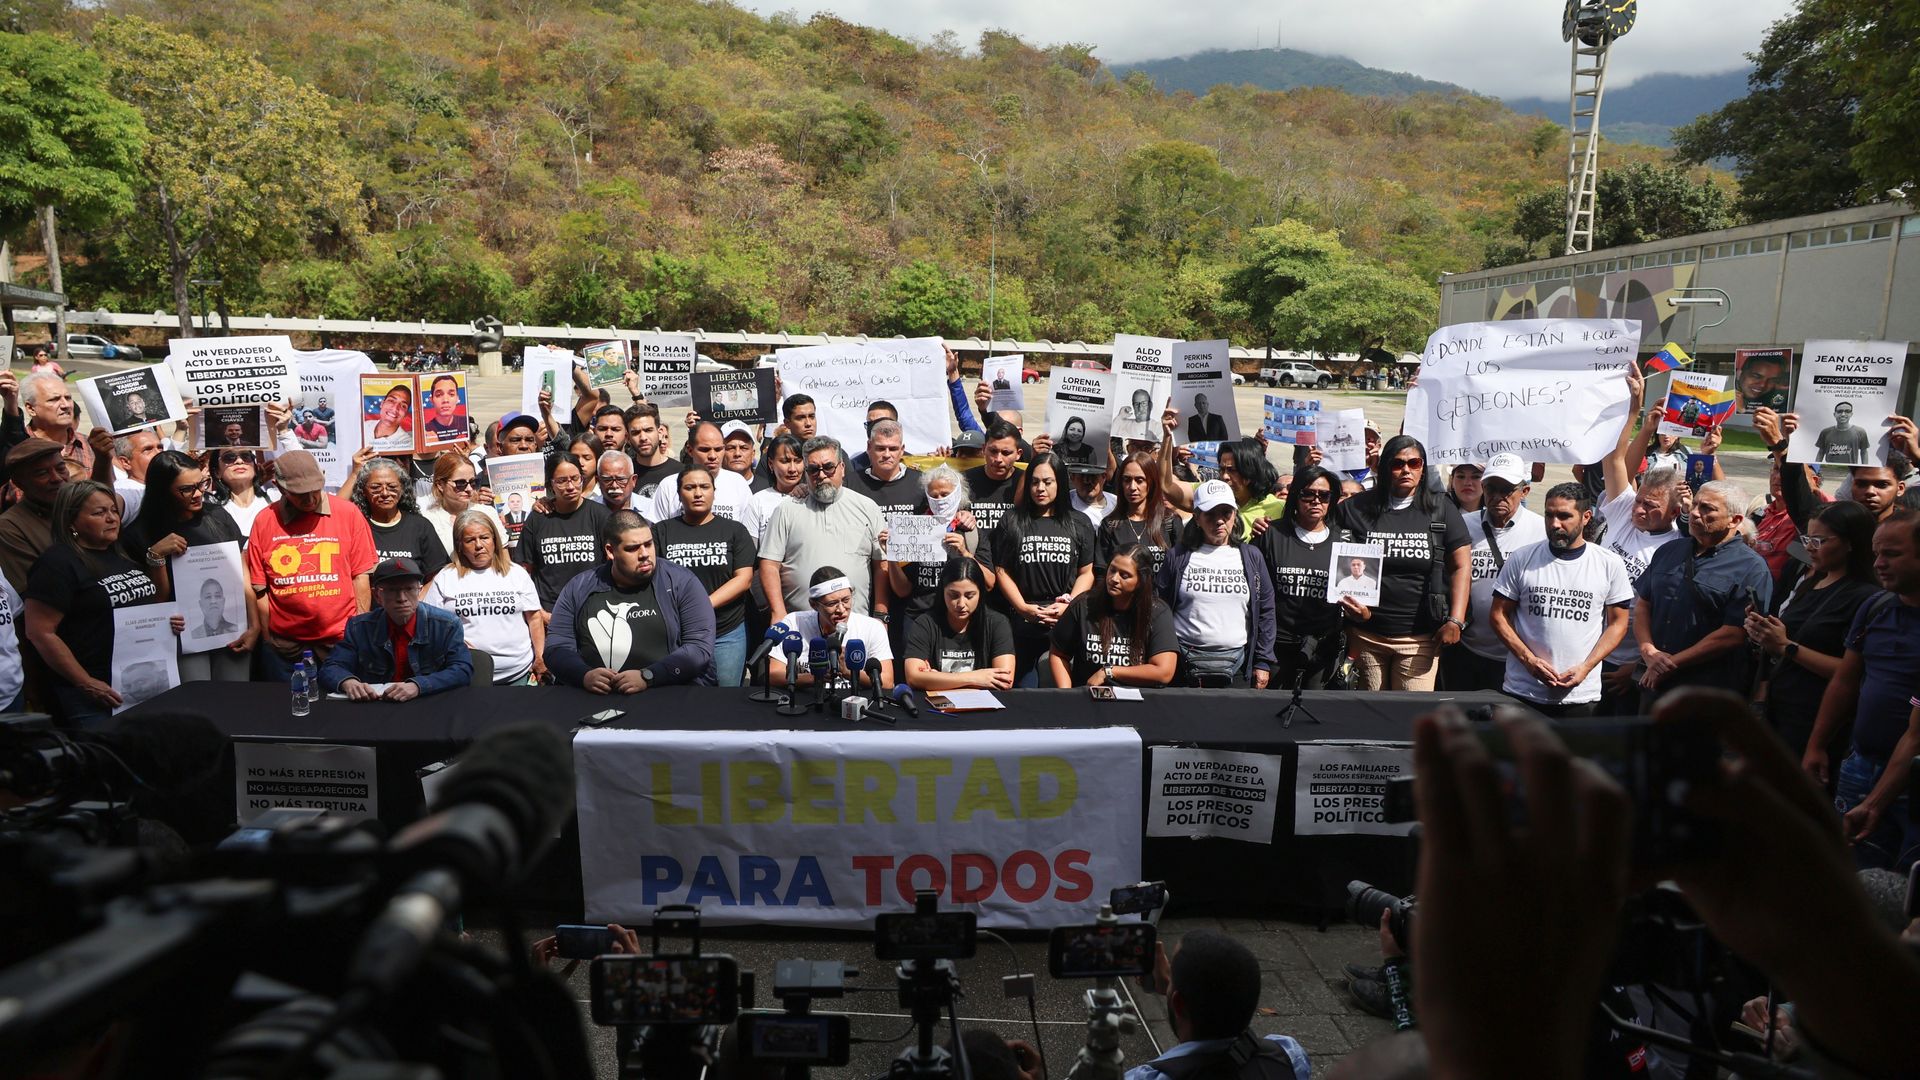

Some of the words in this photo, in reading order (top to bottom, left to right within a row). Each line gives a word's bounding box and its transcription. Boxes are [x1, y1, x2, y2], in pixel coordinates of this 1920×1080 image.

[1504, 326, 1563, 348] ESTÁN
[192, 349, 208, 357] UN
[210, 346, 272, 356] VERDADERO
[1136, 347, 1162, 356] ALDO
[1596, 346, 1628, 356] SEAN
[1136, 355, 1160, 363] ROSO
[645, 362, 656, 370] NI
[659, 362, 674, 370] AL
[676, 362, 689, 370] 1%
[1126, 363, 1171, 372] VENEZOLANO
[1466, 360, 1500, 376] LOS
[188, 370, 236, 380] LIBERTAD
[238, 368, 252, 376] DE
[253, 366, 286, 375] TODOS
[710, 372, 756, 382] LIBERTAD
[196, 384, 224, 394] LOS
[227, 380, 280, 392] PRESOS
[710, 382, 757, 392] HERMANOS
[1063, 376, 1100, 387] LORENIA
[1062, 384, 1101, 394] GUTIERREZ
[1436, 381, 1572, 430] GEDEONES?
[713, 409, 758, 419] GUEVARA
[542, 543, 558, 553] LOS
[560, 542, 594, 551] PRESOS
[1036, 543, 1070, 552] PRESOS
[1388, 539, 1428, 548] PRESOS
[544, 552, 595, 564] POLÍTICOS
[666, 549, 712, 558] CENTROS
[274, 577, 295, 586] CRUZ
[296, 574, 338, 583] VILLEGAS
[1208, 576, 1246, 584] PRESOS
[104, 582, 126, 594] LOS
[299, 584, 326, 592] OBRERA
[316, 588, 340, 596] PODER!
[1186, 582, 1248, 594] POLÍTICOS
[1528, 586, 1558, 594] LIBEREN
[1568, 590, 1594, 599] TODOS
[455, 598, 473, 607] LOS
[476, 596, 516, 604] PRESOS
[1529, 594, 1546, 604] LOS
[1550, 596, 1592, 610] PRESOS
[456, 604, 516, 617] POLÍTICOS
[1528, 605, 1590, 622] POLÍTICOS
[1086, 642, 1102, 652] LOS
[1175, 762, 1190, 770] UN
[1192, 762, 1258, 774] VERDADERO
[1320, 764, 1338, 772] LOS
[1342, 764, 1400, 773] FAMILIARES
[248, 768, 266, 776] NO
[270, 768, 294, 778] MÁS
[298, 769, 366, 780] REPRESIÓN
[1164, 772, 1192, 780] ACTO
[1195, 772, 1208, 780] DE
[1210, 773, 1232, 782] PAZ
[1234, 776, 1248, 784] ES
[1251, 777, 1264, 786] LA
[288, 785, 366, 795] DESAPARECIDOS
[650, 756, 1078, 826] LIBERTAD
[1164, 784, 1210, 794] LIBERTAD
[1213, 786, 1226, 795] DE
[1230, 788, 1264, 800] TODOS
[1312, 785, 1356, 794] LIBERTAD
[250, 800, 270, 808] NO
[274, 798, 302, 808] MÁS
[306, 800, 367, 812] TORTURA
[1168, 800, 1194, 811] LOS
[1197, 800, 1252, 815] PRESOS
[1314, 798, 1340, 808] LOS
[1167, 811, 1250, 830] POLÍTICOS
[640, 854, 834, 906] PARA
[852, 849, 1094, 906] TODOS
